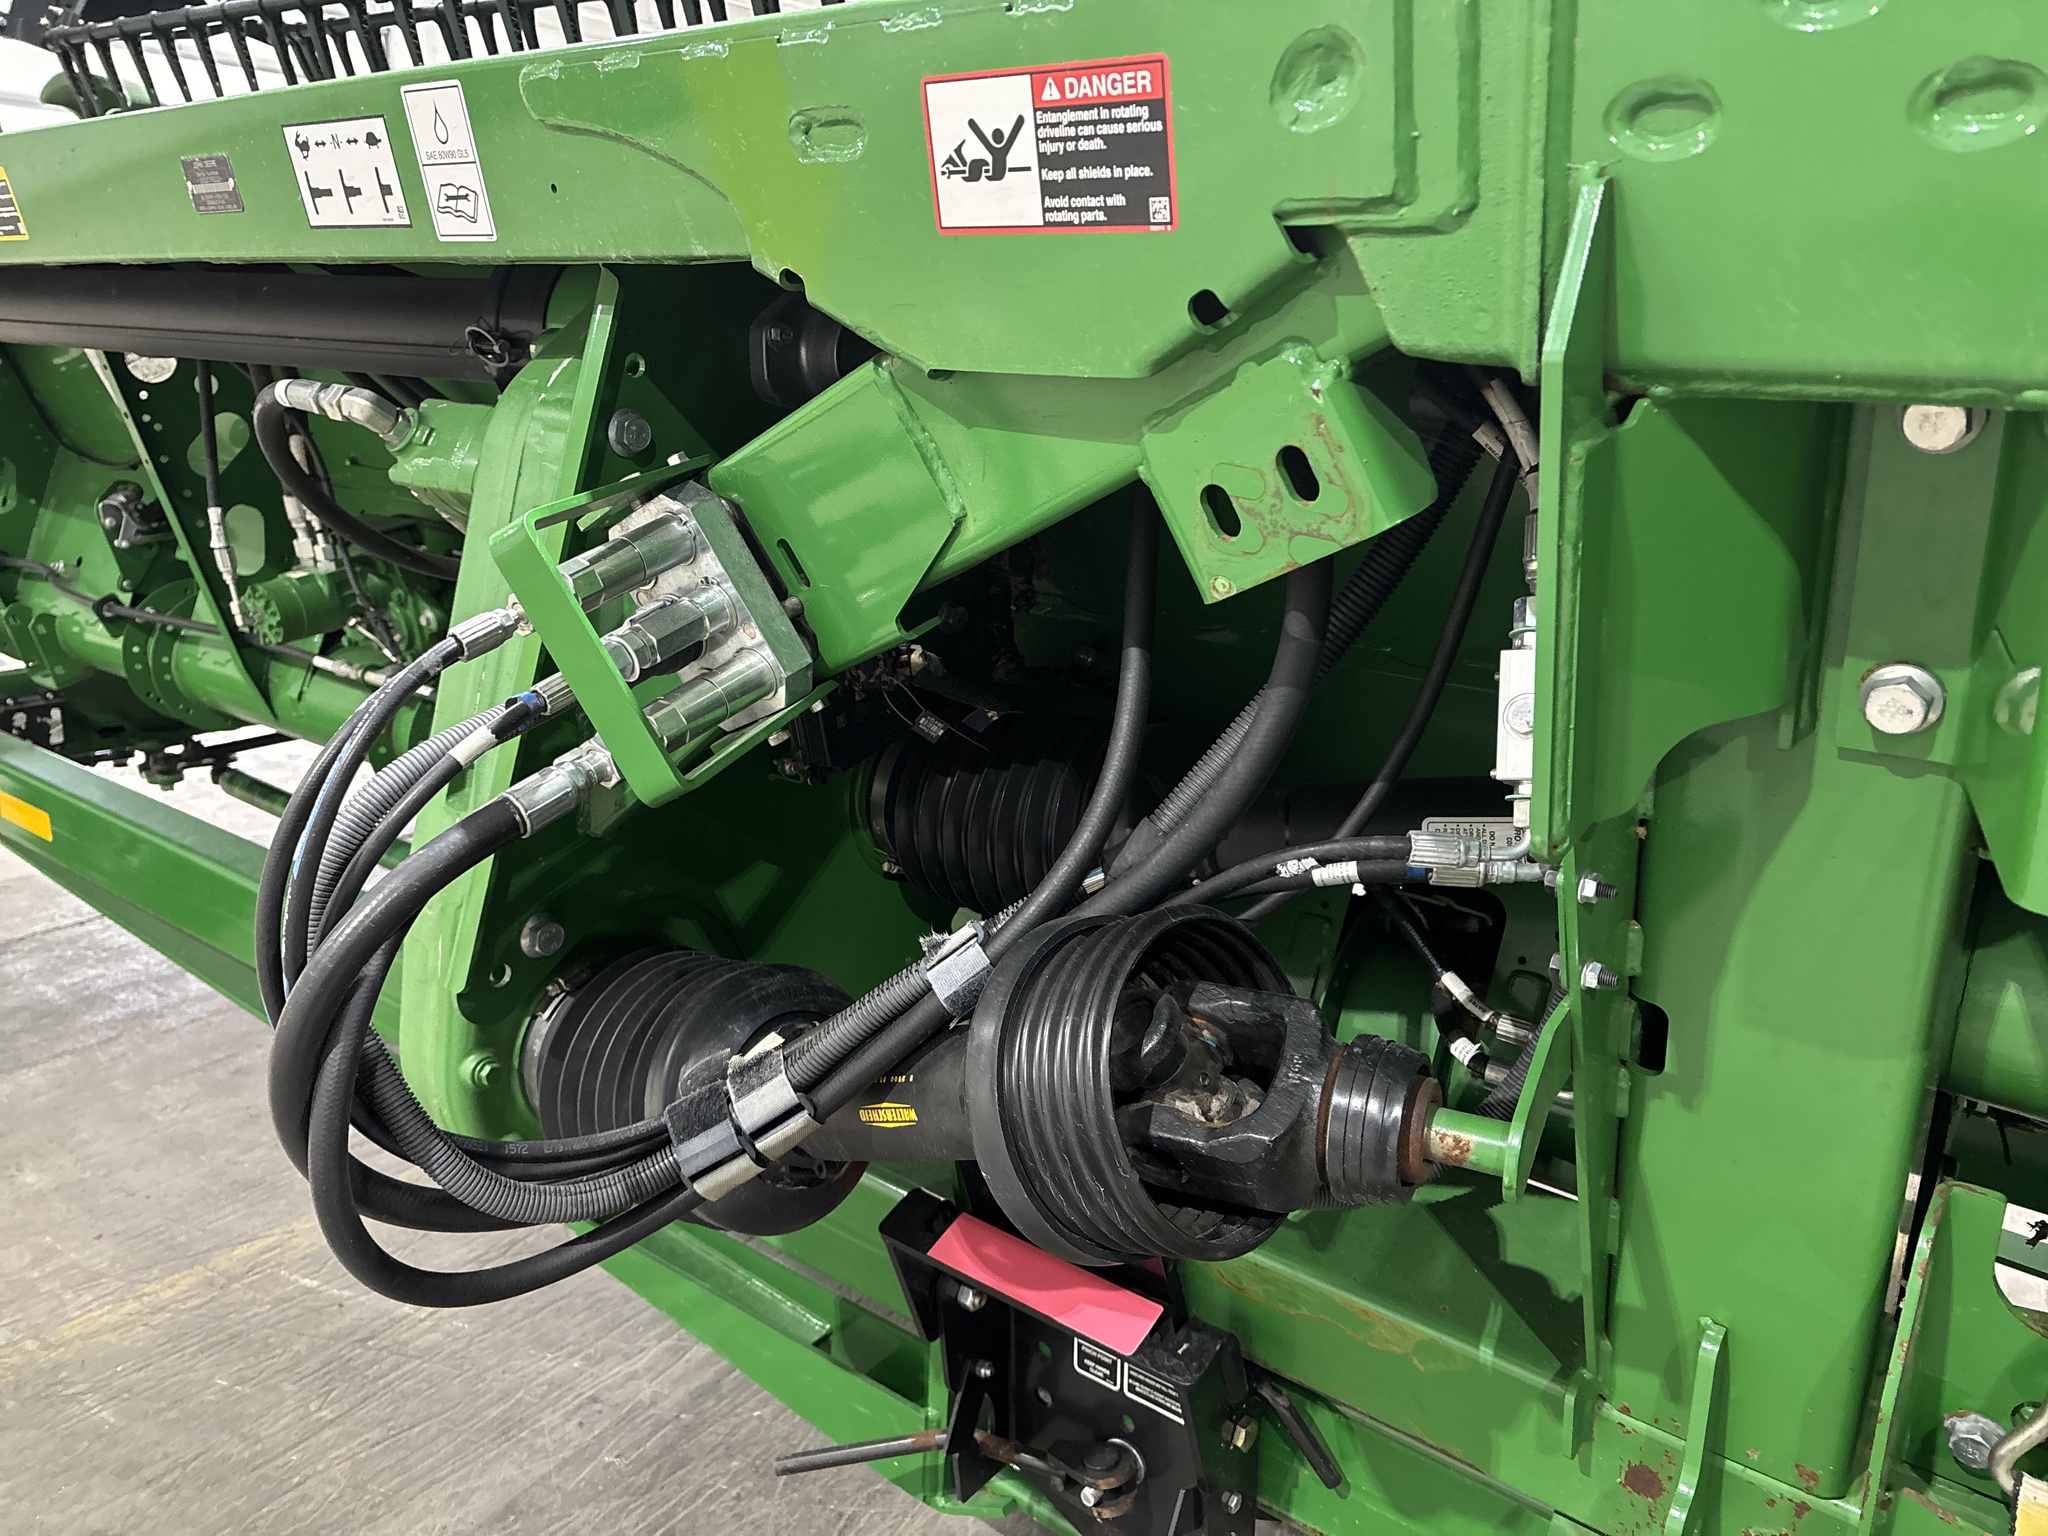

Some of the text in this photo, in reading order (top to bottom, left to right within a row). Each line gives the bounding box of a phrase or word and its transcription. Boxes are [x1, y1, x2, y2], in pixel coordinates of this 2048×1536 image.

[1064, 70, 1152, 99] DANGER
[1036, 104, 1149, 125] Entanglement in rotating
[1037, 119, 1163, 139] driveline can cause serious
[425, 149, 469, 160] SAE 80W90 GL5
[1039, 137, 1107, 155] injury or death.
[1041, 164, 1154, 183] Keep all shields in place.
[1044, 193, 1127, 208] Avoid contact with
[1045, 209, 1107, 224] rotating parts.
[859, 1108, 918, 1122] WALTERSCHEID
